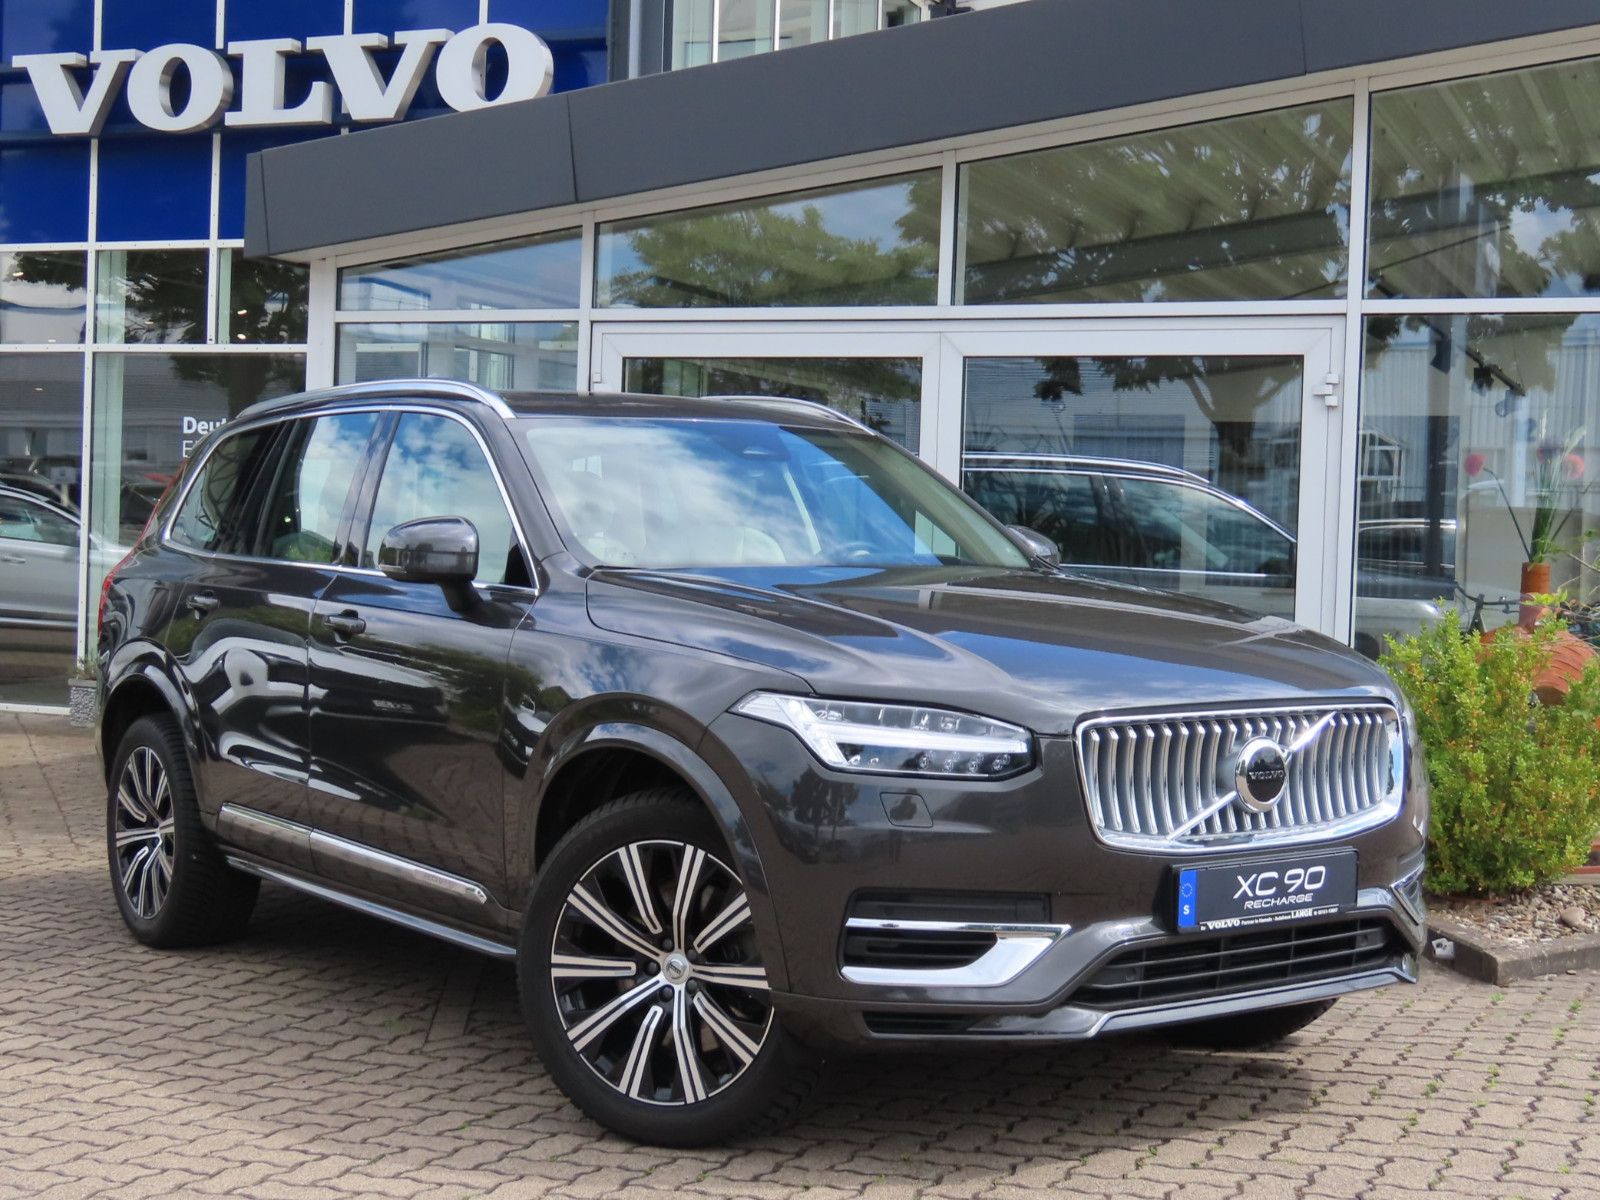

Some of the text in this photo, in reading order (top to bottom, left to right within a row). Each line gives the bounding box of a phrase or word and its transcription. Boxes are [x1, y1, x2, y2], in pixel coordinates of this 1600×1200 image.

[12, 23, 554, 134] VOLVO
[1249, 770, 1284, 780] VOLVO
[1244, 893, 1314, 910] RECHARGE
[1183, 905, 1190, 915] S
[1207, 919, 1240, 930] VOLVO
